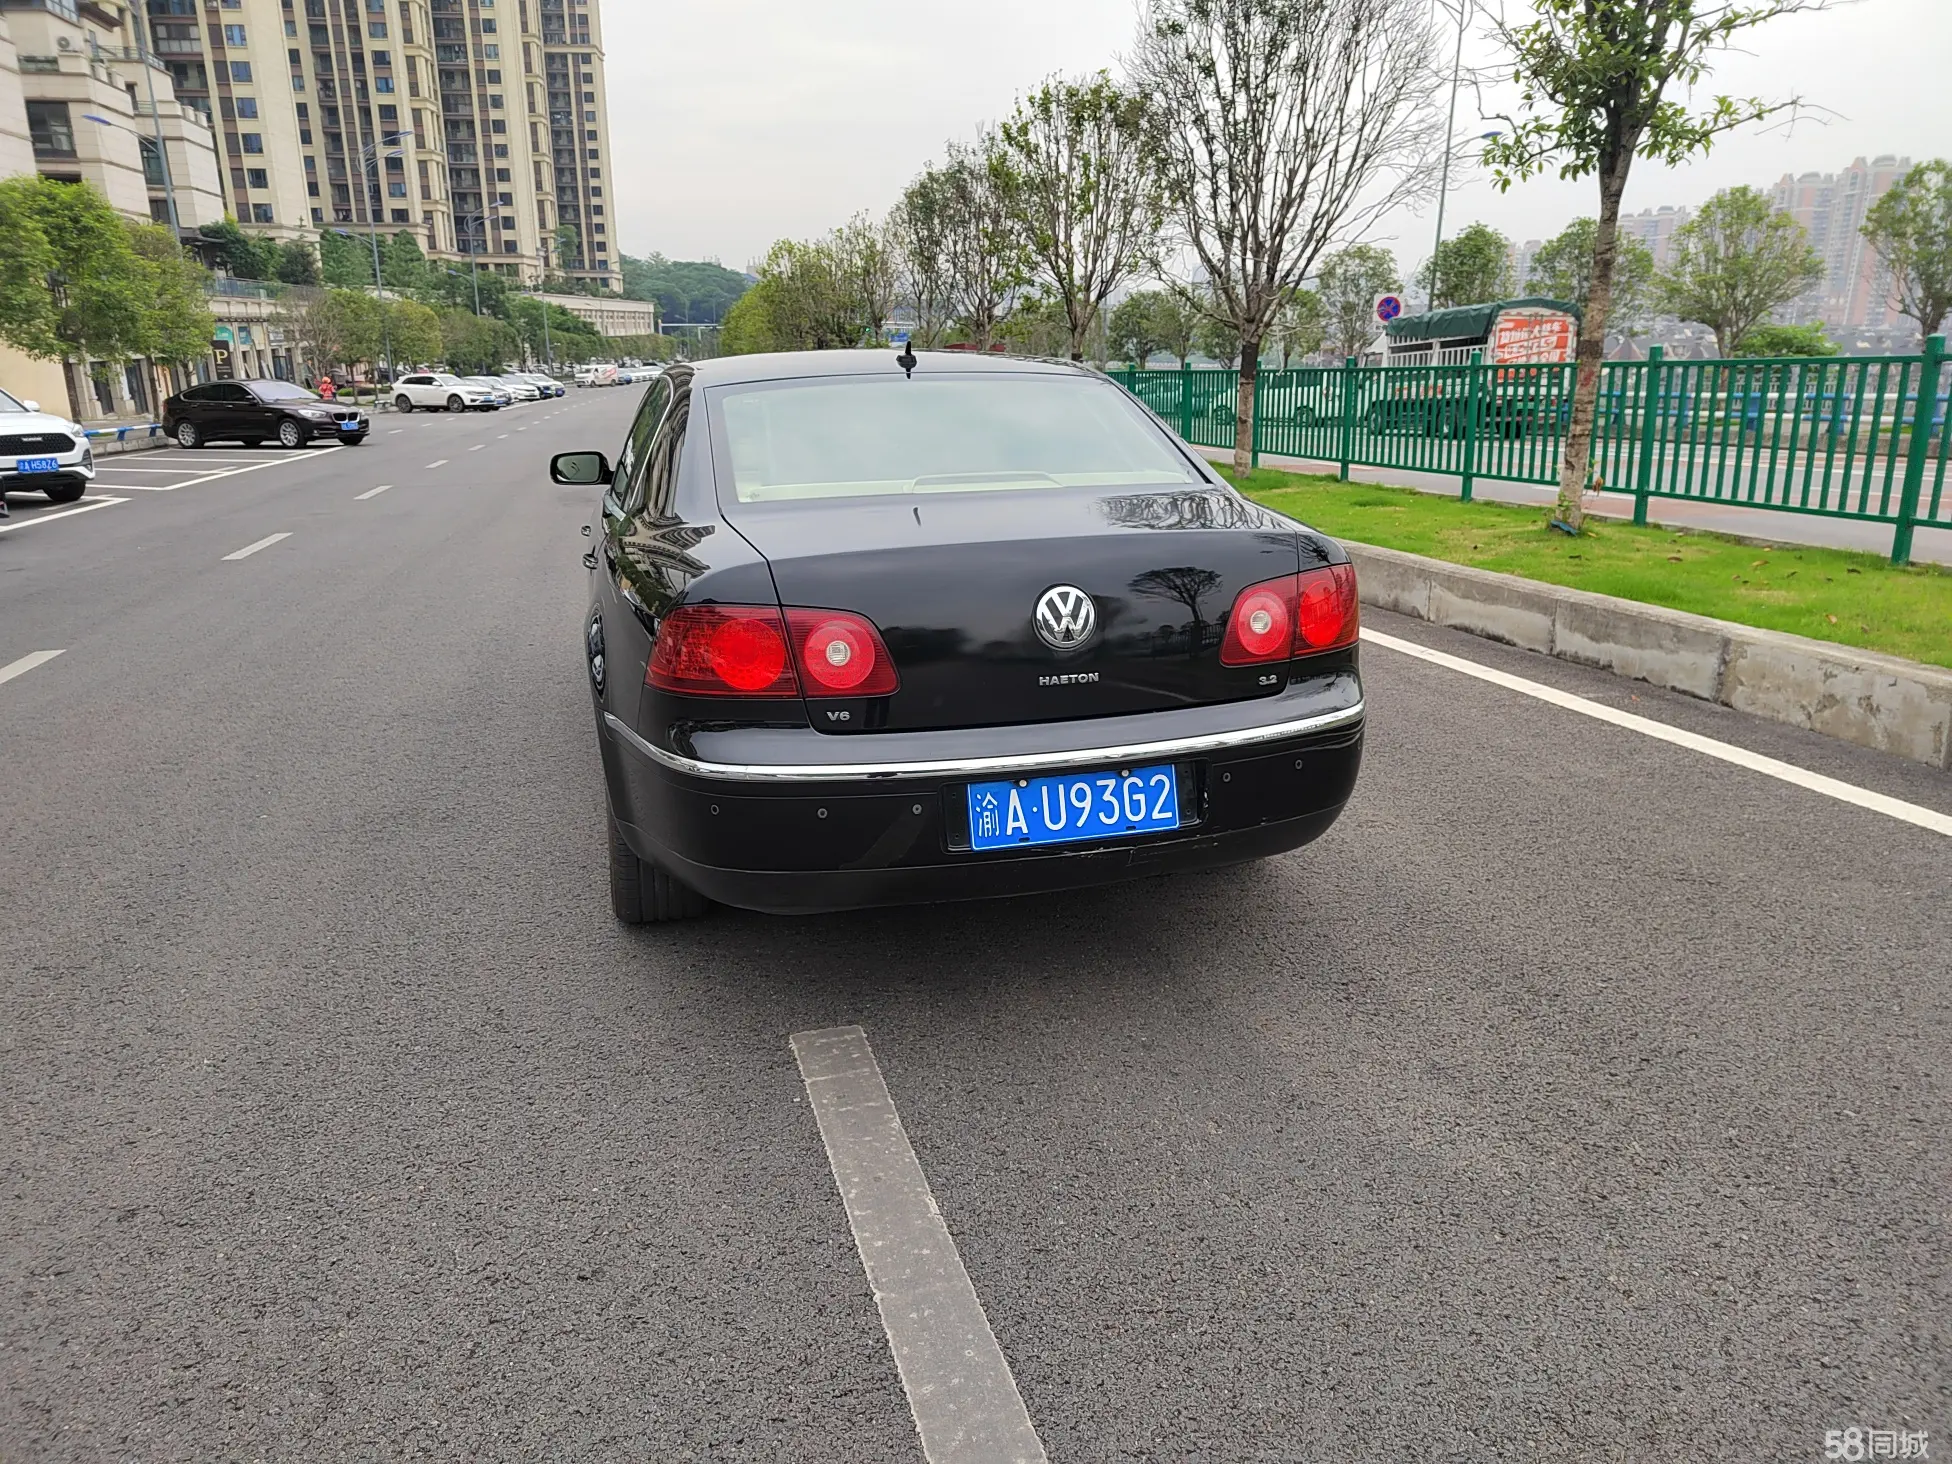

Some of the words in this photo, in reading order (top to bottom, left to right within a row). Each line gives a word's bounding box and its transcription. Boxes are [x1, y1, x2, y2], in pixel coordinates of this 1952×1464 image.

[1039, 673, 1099, 686] HAETON
[1259, 675, 1278, 685] 3.2
[826, 711, 850, 721] V6
